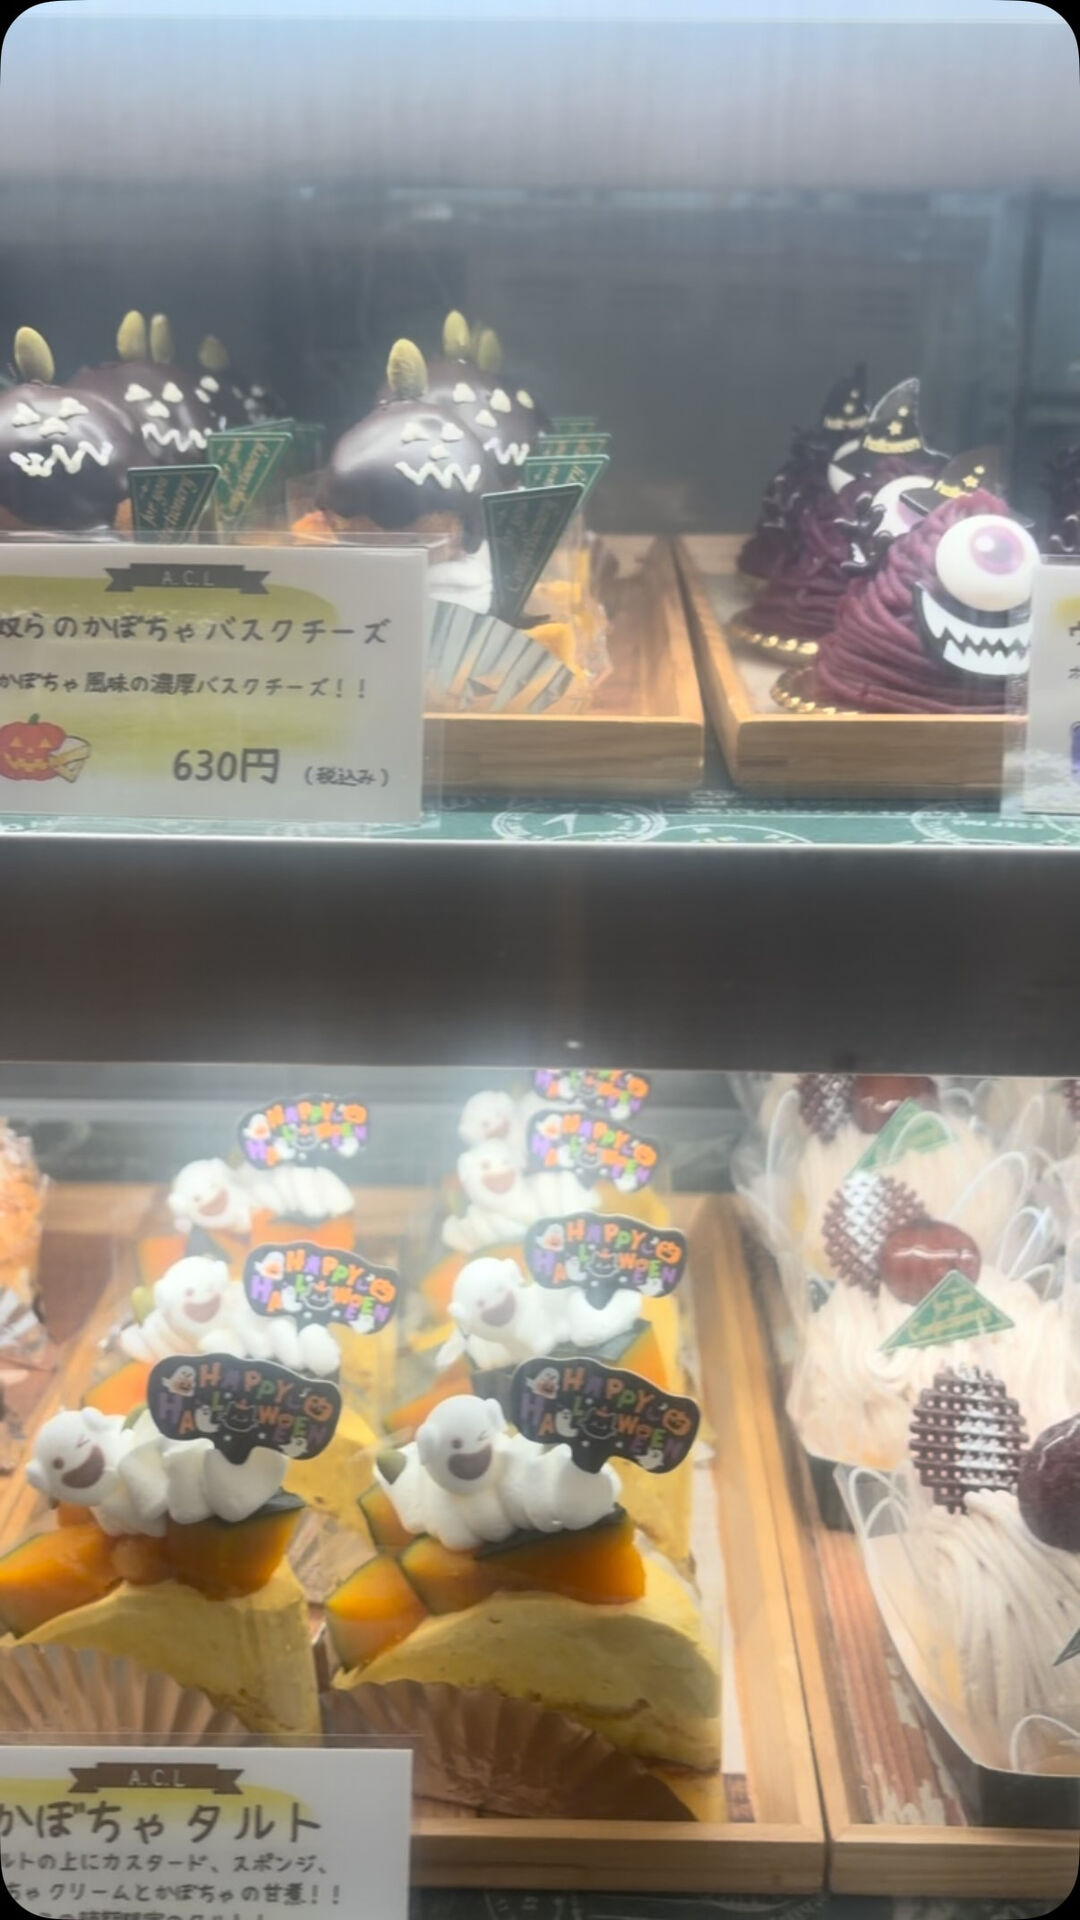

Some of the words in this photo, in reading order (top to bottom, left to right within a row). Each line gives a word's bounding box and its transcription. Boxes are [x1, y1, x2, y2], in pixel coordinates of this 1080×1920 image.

[172, 747, 281, 785] 630円
[304, 766, 390, 788] （税込み）
[285, 1249, 364, 1285] HAPPY
[200, 1362, 294, 1404] HAPPY
[563, 1367, 654, 1413] HAPPY
[128, 1768, 186, 1788] A.C.L
[1, 1799, 322, 1845] かぼちゃタルト
